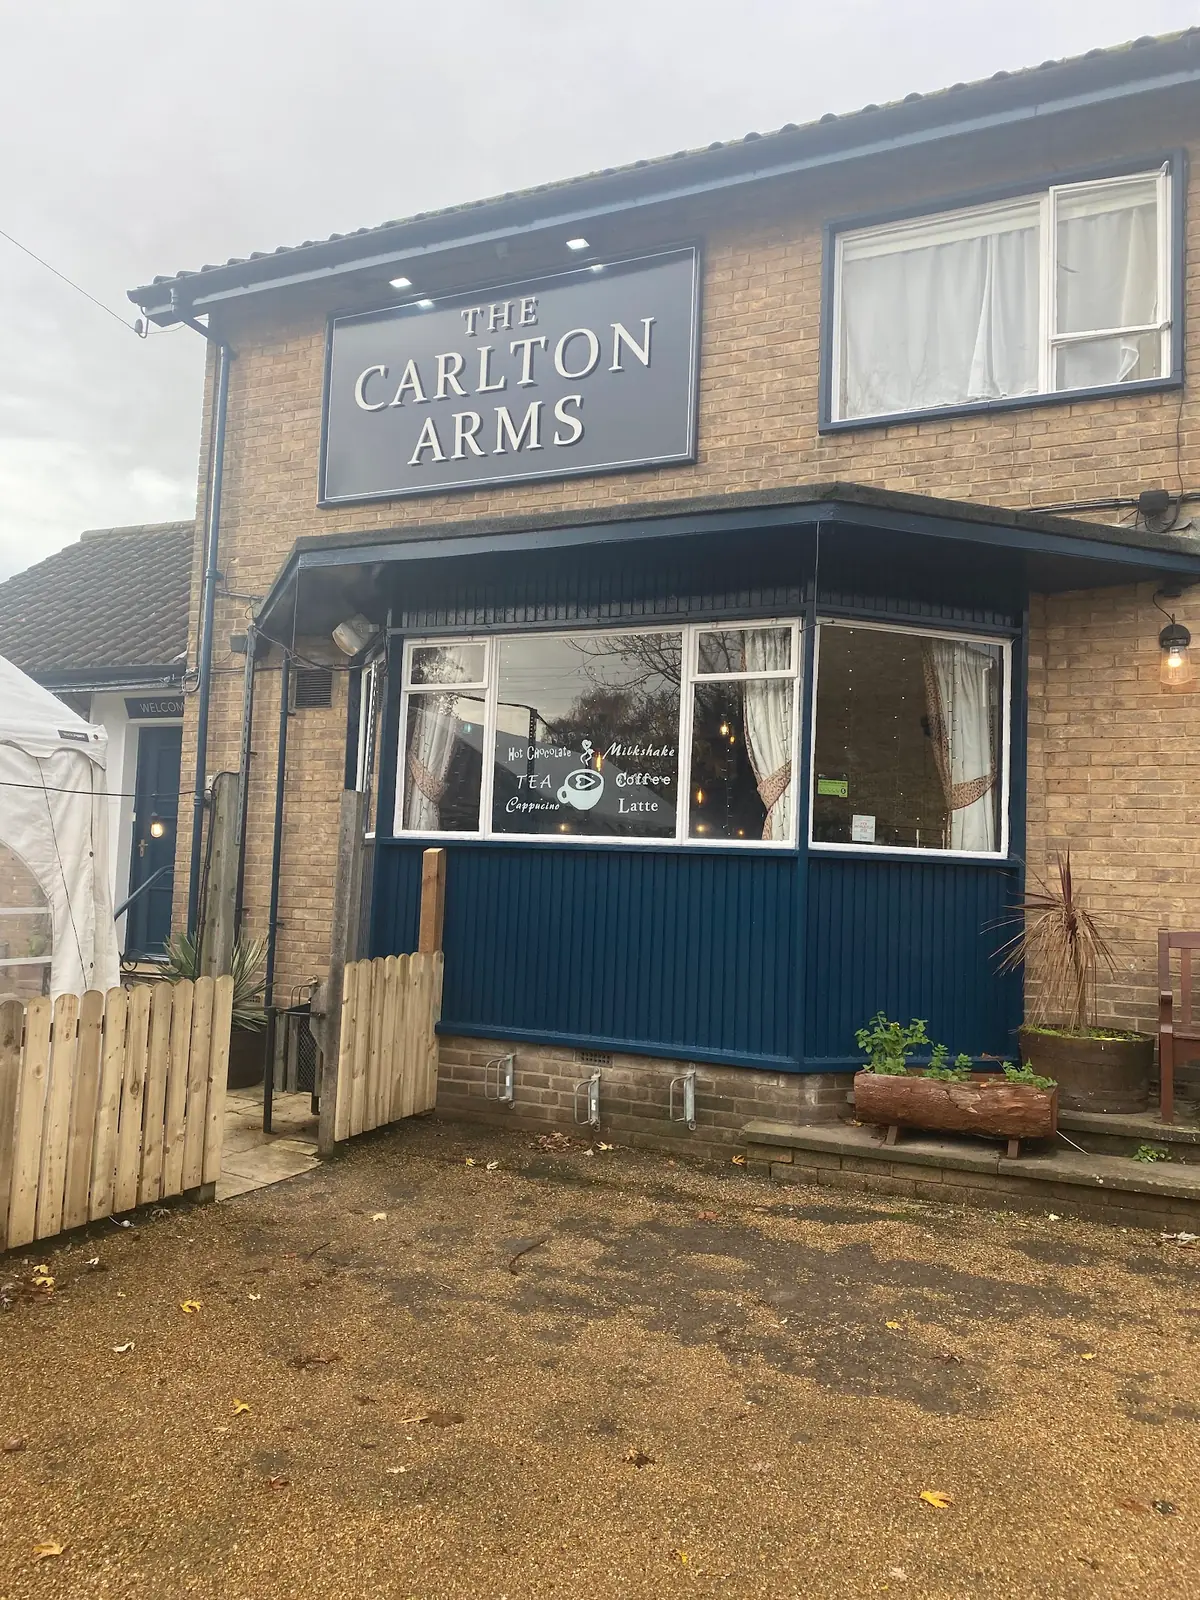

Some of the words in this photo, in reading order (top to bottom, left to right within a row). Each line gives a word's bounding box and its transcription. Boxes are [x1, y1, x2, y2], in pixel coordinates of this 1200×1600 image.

[461, 296, 538, 336] THE
[354, 317, 655, 412] CARLTON
[407, 394, 584, 465] ARMS
[140, 702, 184, 713] WELCOM
[508, 746, 523, 761] Hot
[602, 742, 675, 760] Milkshake
[516, 774, 552, 790] TEA
[615, 772, 671, 788] Coffee
[506, 796, 560, 813] Cappucino
[618, 798, 659, 814] Latte
